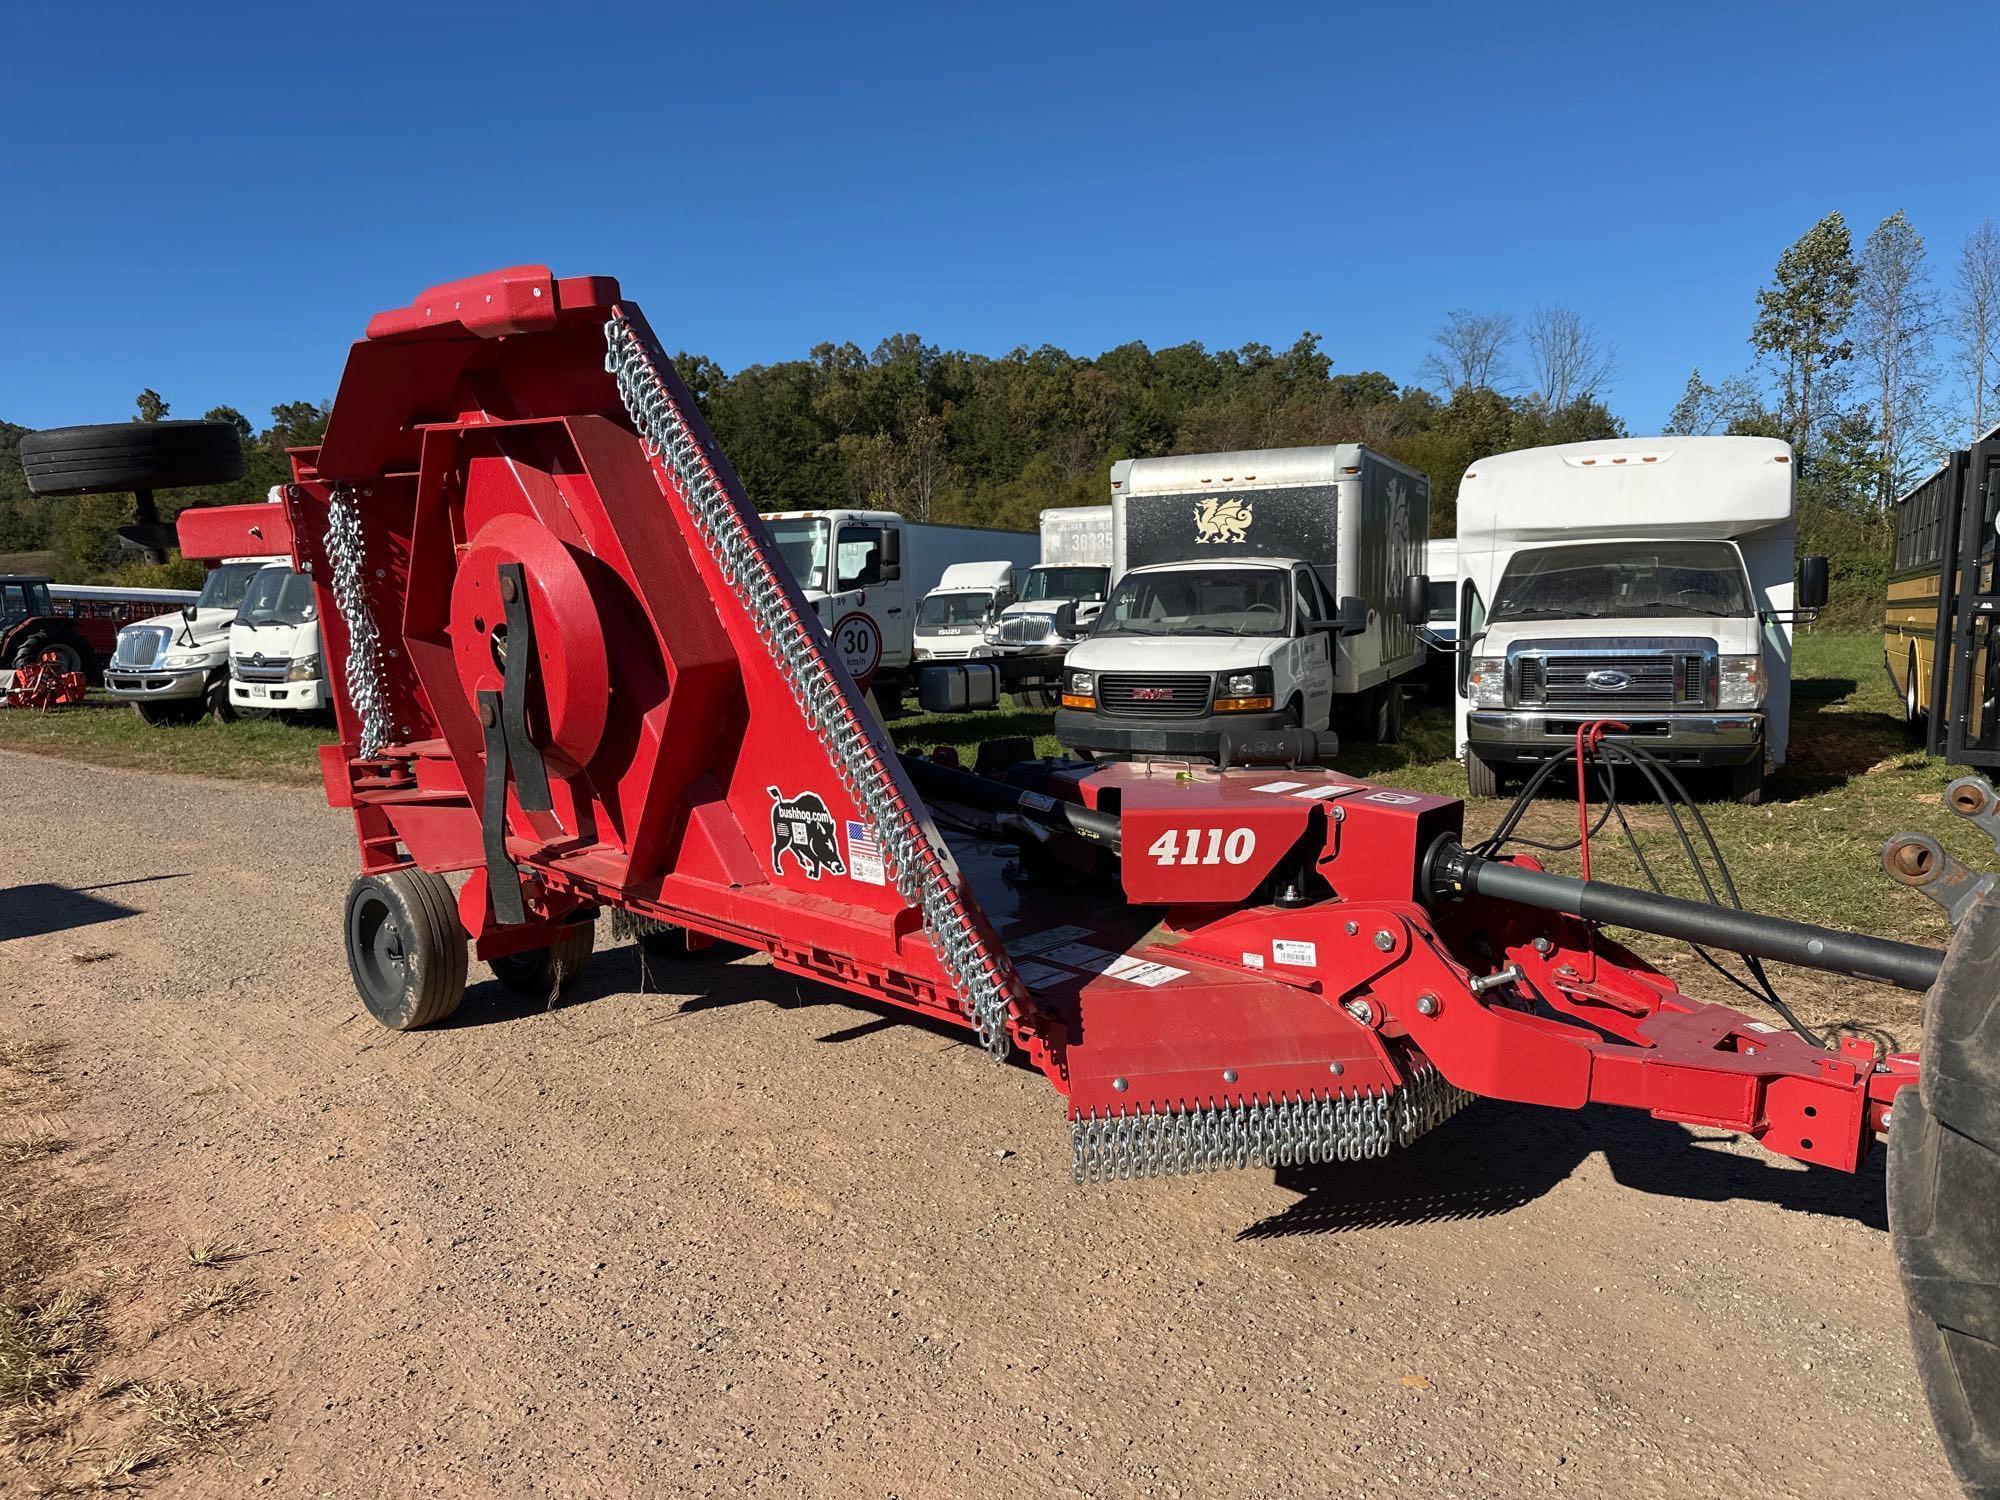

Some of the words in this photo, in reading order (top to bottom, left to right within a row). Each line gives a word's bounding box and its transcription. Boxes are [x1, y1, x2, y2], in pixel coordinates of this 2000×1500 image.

[836, 597, 846, 606] 39
[938, 628, 961, 636] ISUZU
[843, 629, 869, 655] 30
[846, 656, 866, 666] km/h
[1132, 687, 1174, 700] GMC
[778, 805, 830, 825] bushhog.com
[1147, 827, 1257, 866] 4110
